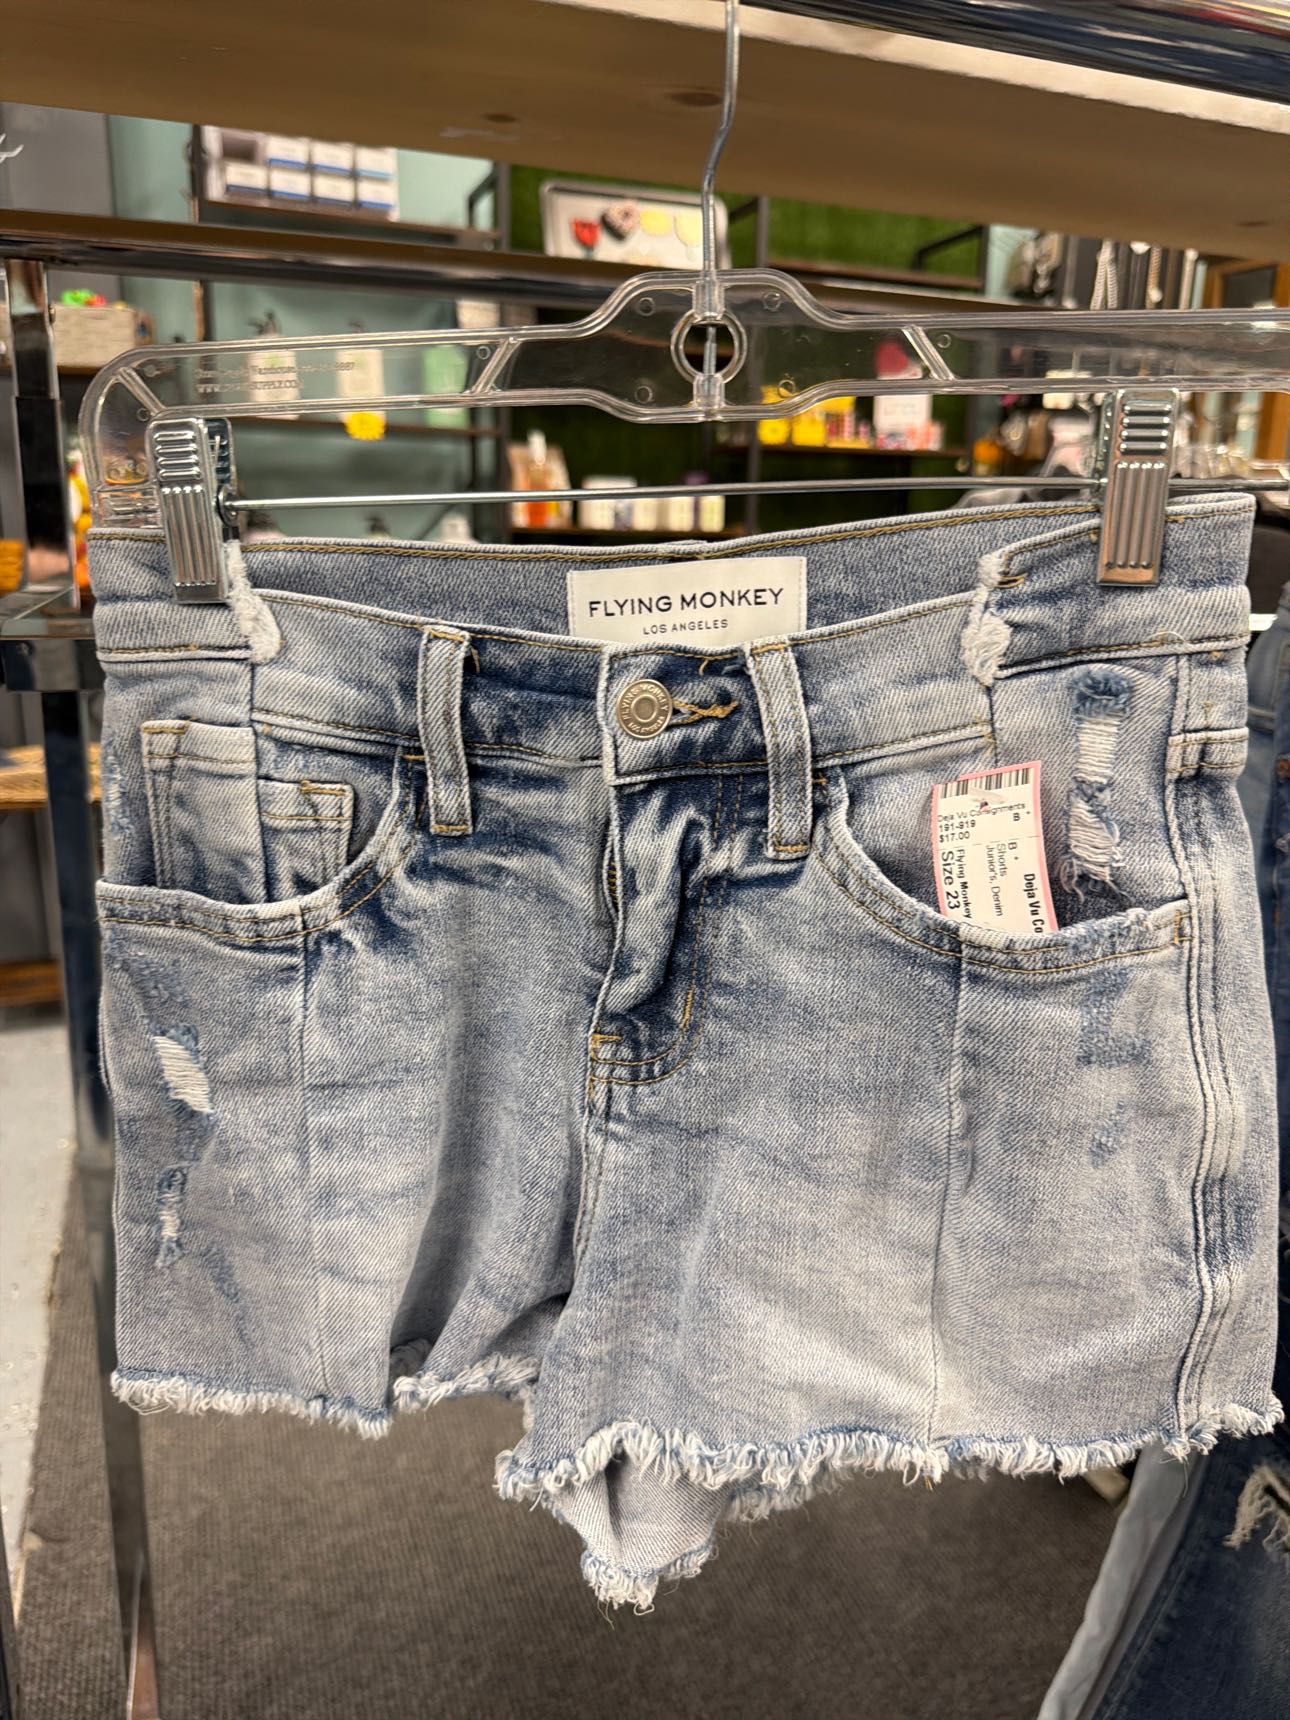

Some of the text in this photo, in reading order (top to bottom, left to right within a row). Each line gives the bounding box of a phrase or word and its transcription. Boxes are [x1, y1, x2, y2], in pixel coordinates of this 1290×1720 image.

[588, 587, 784, 618] FLYING MONKEY
[643, 618, 729, 636] LOS ANGELES
[937, 813, 954, 823] Deja
[957, 811, 968, 819] Vu
[939, 831, 970, 843] $17.00
[997, 843, 1007, 877] Shorts
[941, 850, 961, 910] Size 23
[955, 848, 973, 919] Flying Monkey
[986, 845, 1003, 916] Junior's, Denim
[1023, 873, 1045, 934] Deja Vu Co
